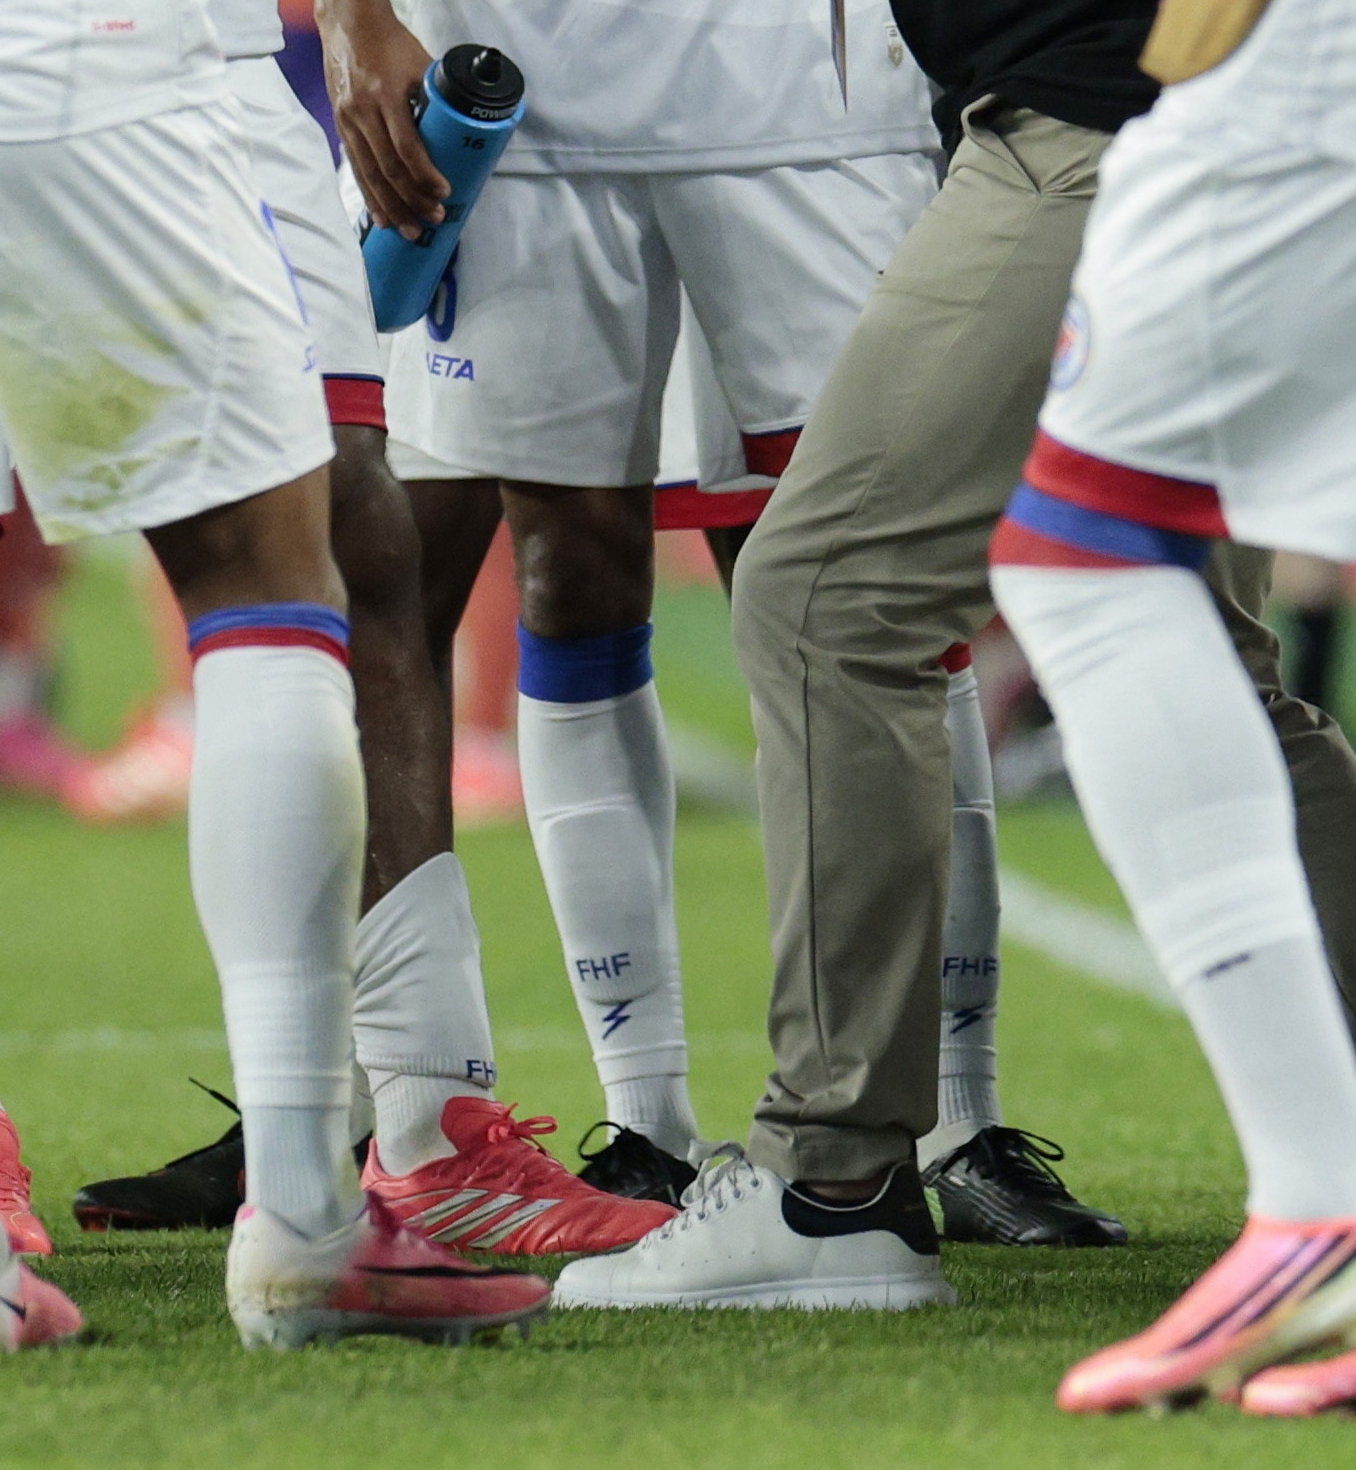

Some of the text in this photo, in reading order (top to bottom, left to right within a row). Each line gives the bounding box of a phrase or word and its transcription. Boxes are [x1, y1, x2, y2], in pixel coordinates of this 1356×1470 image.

[463, 135, 487, 151] 16
[426, 352, 475, 382] ETA
[575, 952, 631, 982] FHF
[943, 956, 998, 979] FHF
